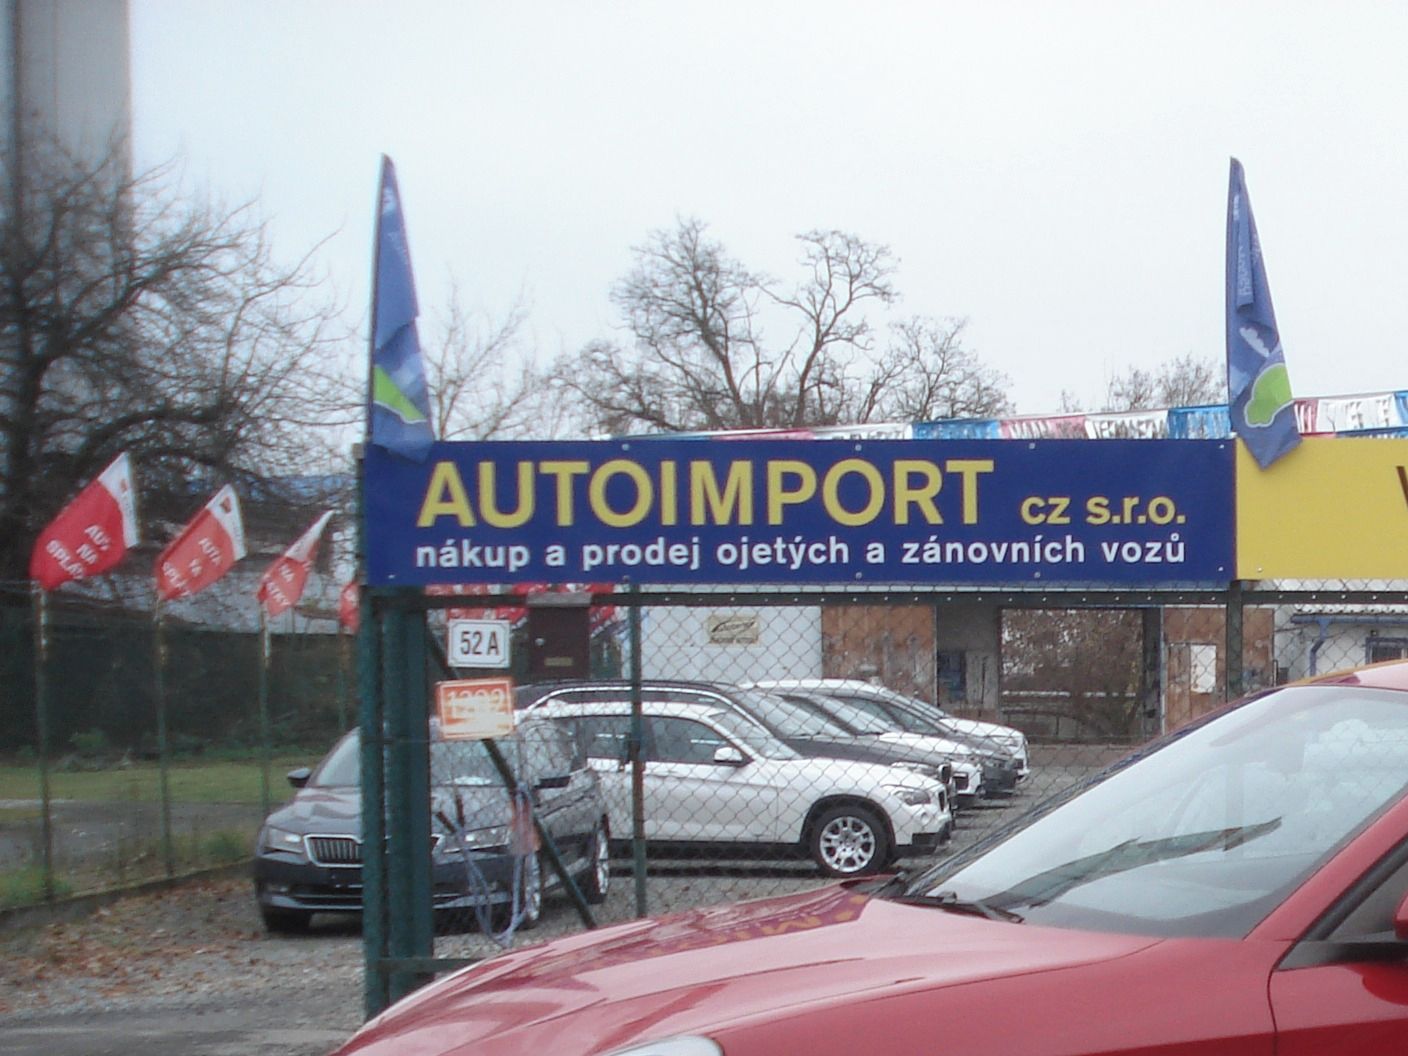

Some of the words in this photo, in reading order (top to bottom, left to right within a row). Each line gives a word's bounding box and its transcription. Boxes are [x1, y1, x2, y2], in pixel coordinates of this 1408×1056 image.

[416, 458, 994, 528] AUTOIMPORT
[1020, 496, 1071, 525] cz
[1086, 496, 1186, 525] s.r.o.
[416, 538, 530, 572] nákup
[545, 543, 566, 567] a
[582, 537, 700, 571] prodej
[717, 535, 849, 570] ojetých
[866, 540, 885, 564] a
[902, 534, 1085, 564] zánovních
[1101, 532, 1185, 563] vozů
[460, 630, 483, 655] 52
[487, 630, 500, 655] A
